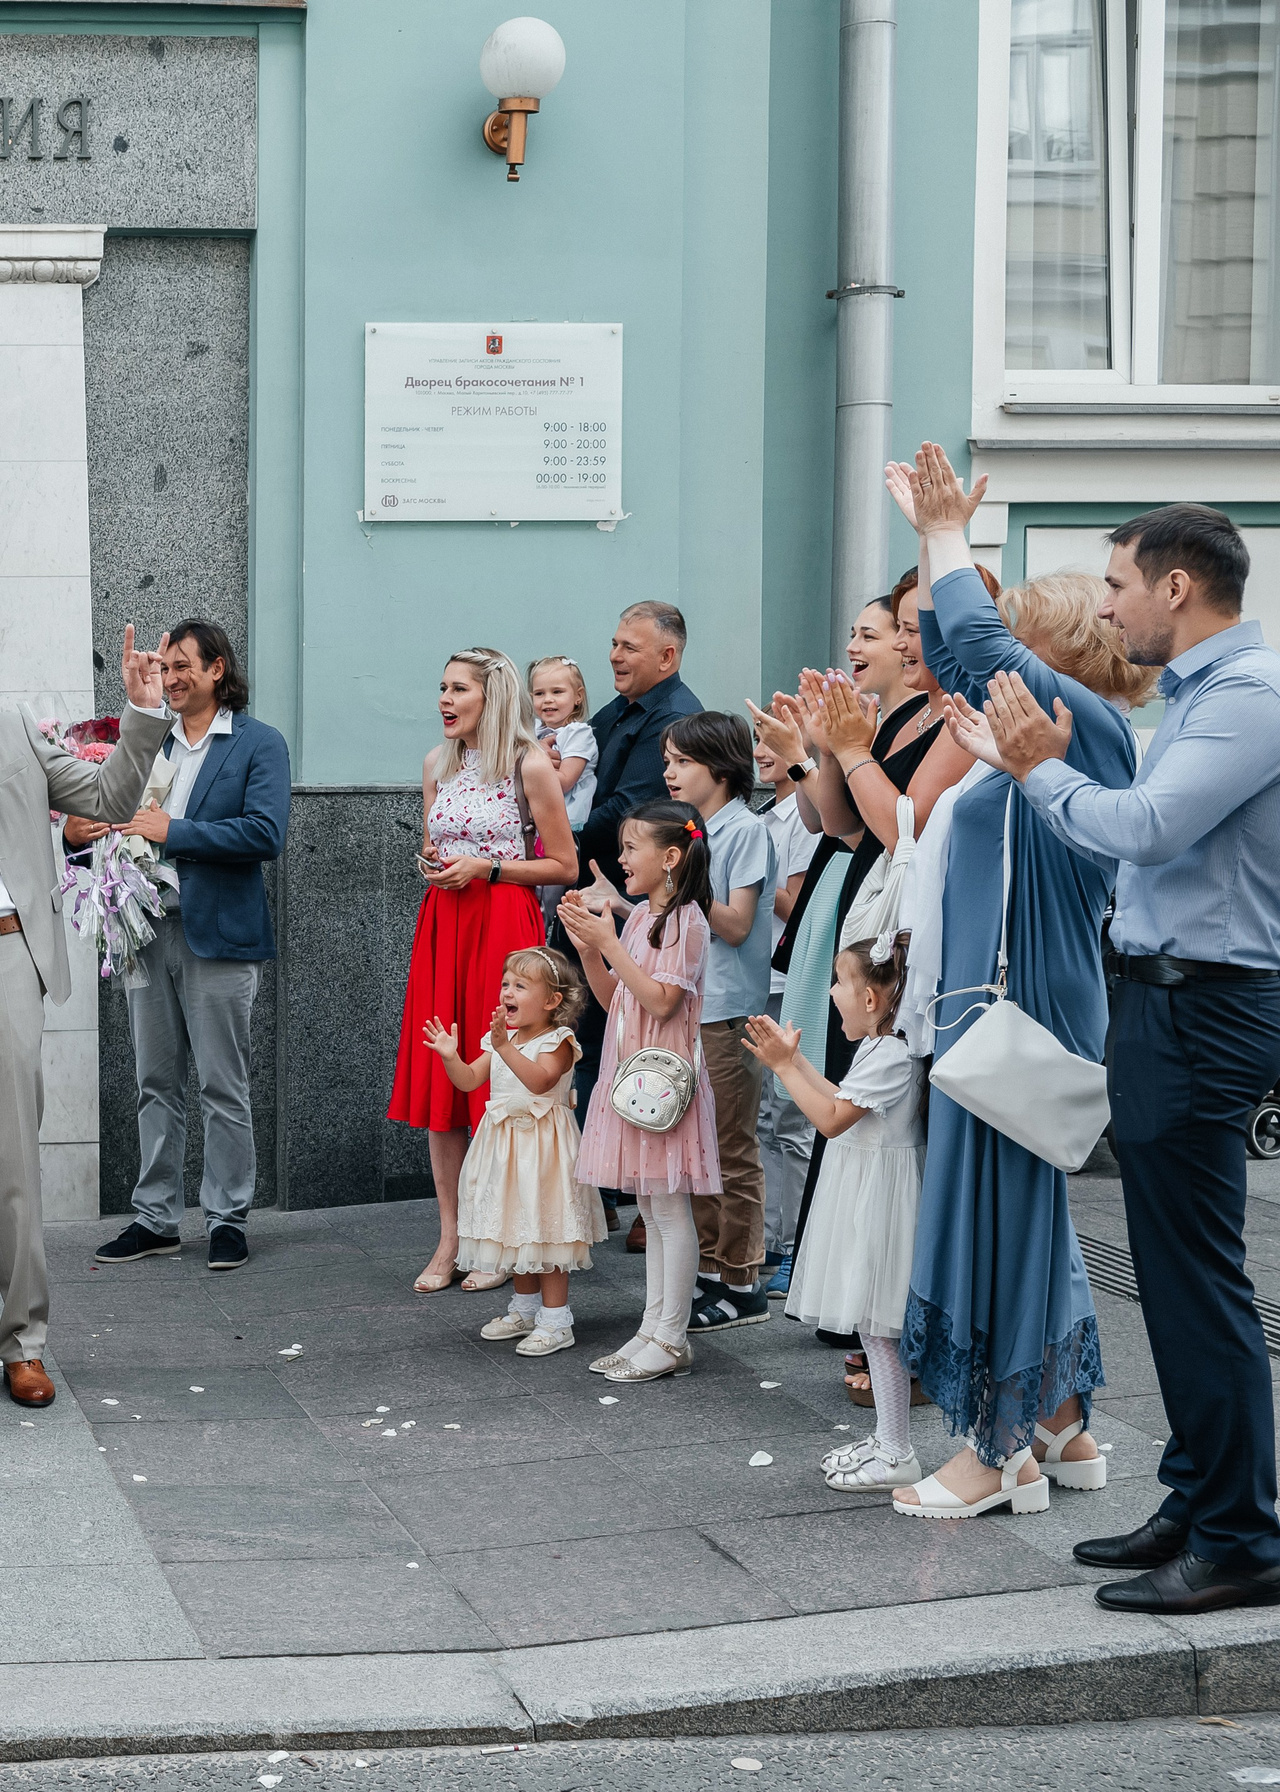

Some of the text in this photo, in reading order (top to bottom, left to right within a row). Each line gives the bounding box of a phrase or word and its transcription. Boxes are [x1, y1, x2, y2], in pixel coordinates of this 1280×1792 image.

[404, 376, 585, 389] Дворец бракосочетания № 1
[451, 406, 537, 416] РЕЖИМ РАБОТЫ
[543, 422, 568, 432] 9:00
[578, 422, 607, 432] 18:00
[543, 439, 568, 449] 9:00
[576, 439, 607, 449] 20:00
[543, 456, 567, 466] 9:00
[576, 456, 607, 466] 23:59
[536, 473, 567, 483] 00:00
[577, 473, 606, 483] 19:00
